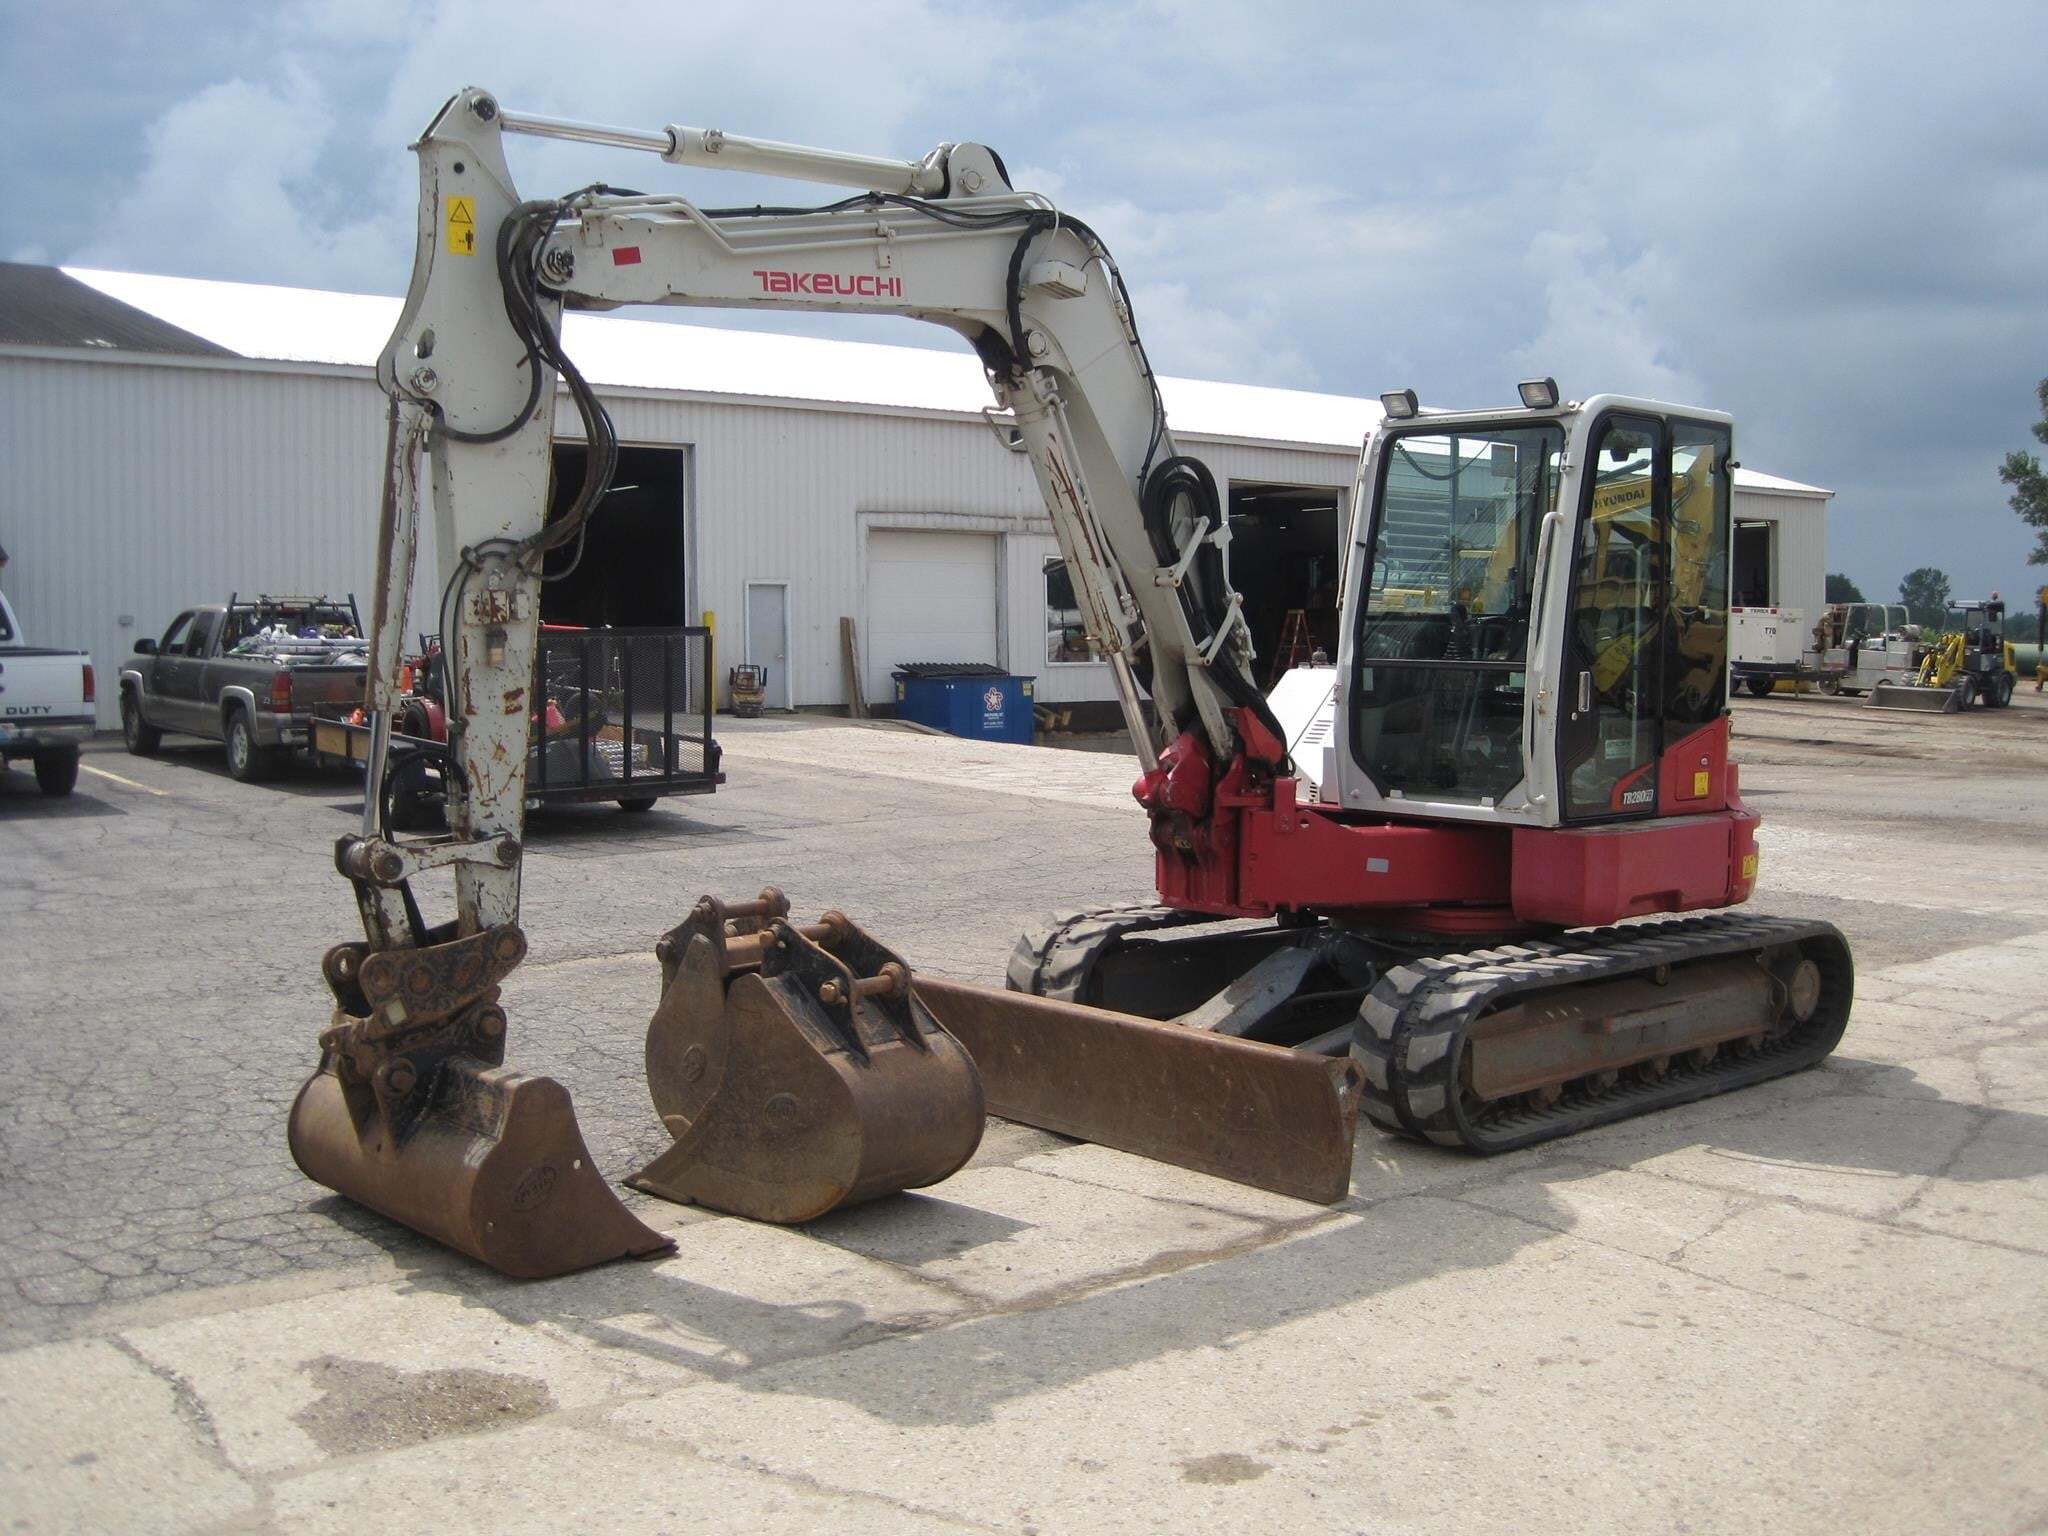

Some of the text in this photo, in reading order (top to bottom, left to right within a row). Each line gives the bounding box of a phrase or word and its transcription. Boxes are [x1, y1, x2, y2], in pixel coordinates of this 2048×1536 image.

[753, 270, 902, 297] TAKEUCHI
[1594, 489, 1645, 509] HYUNDAI
[6, 706, 52, 715] DUTY
